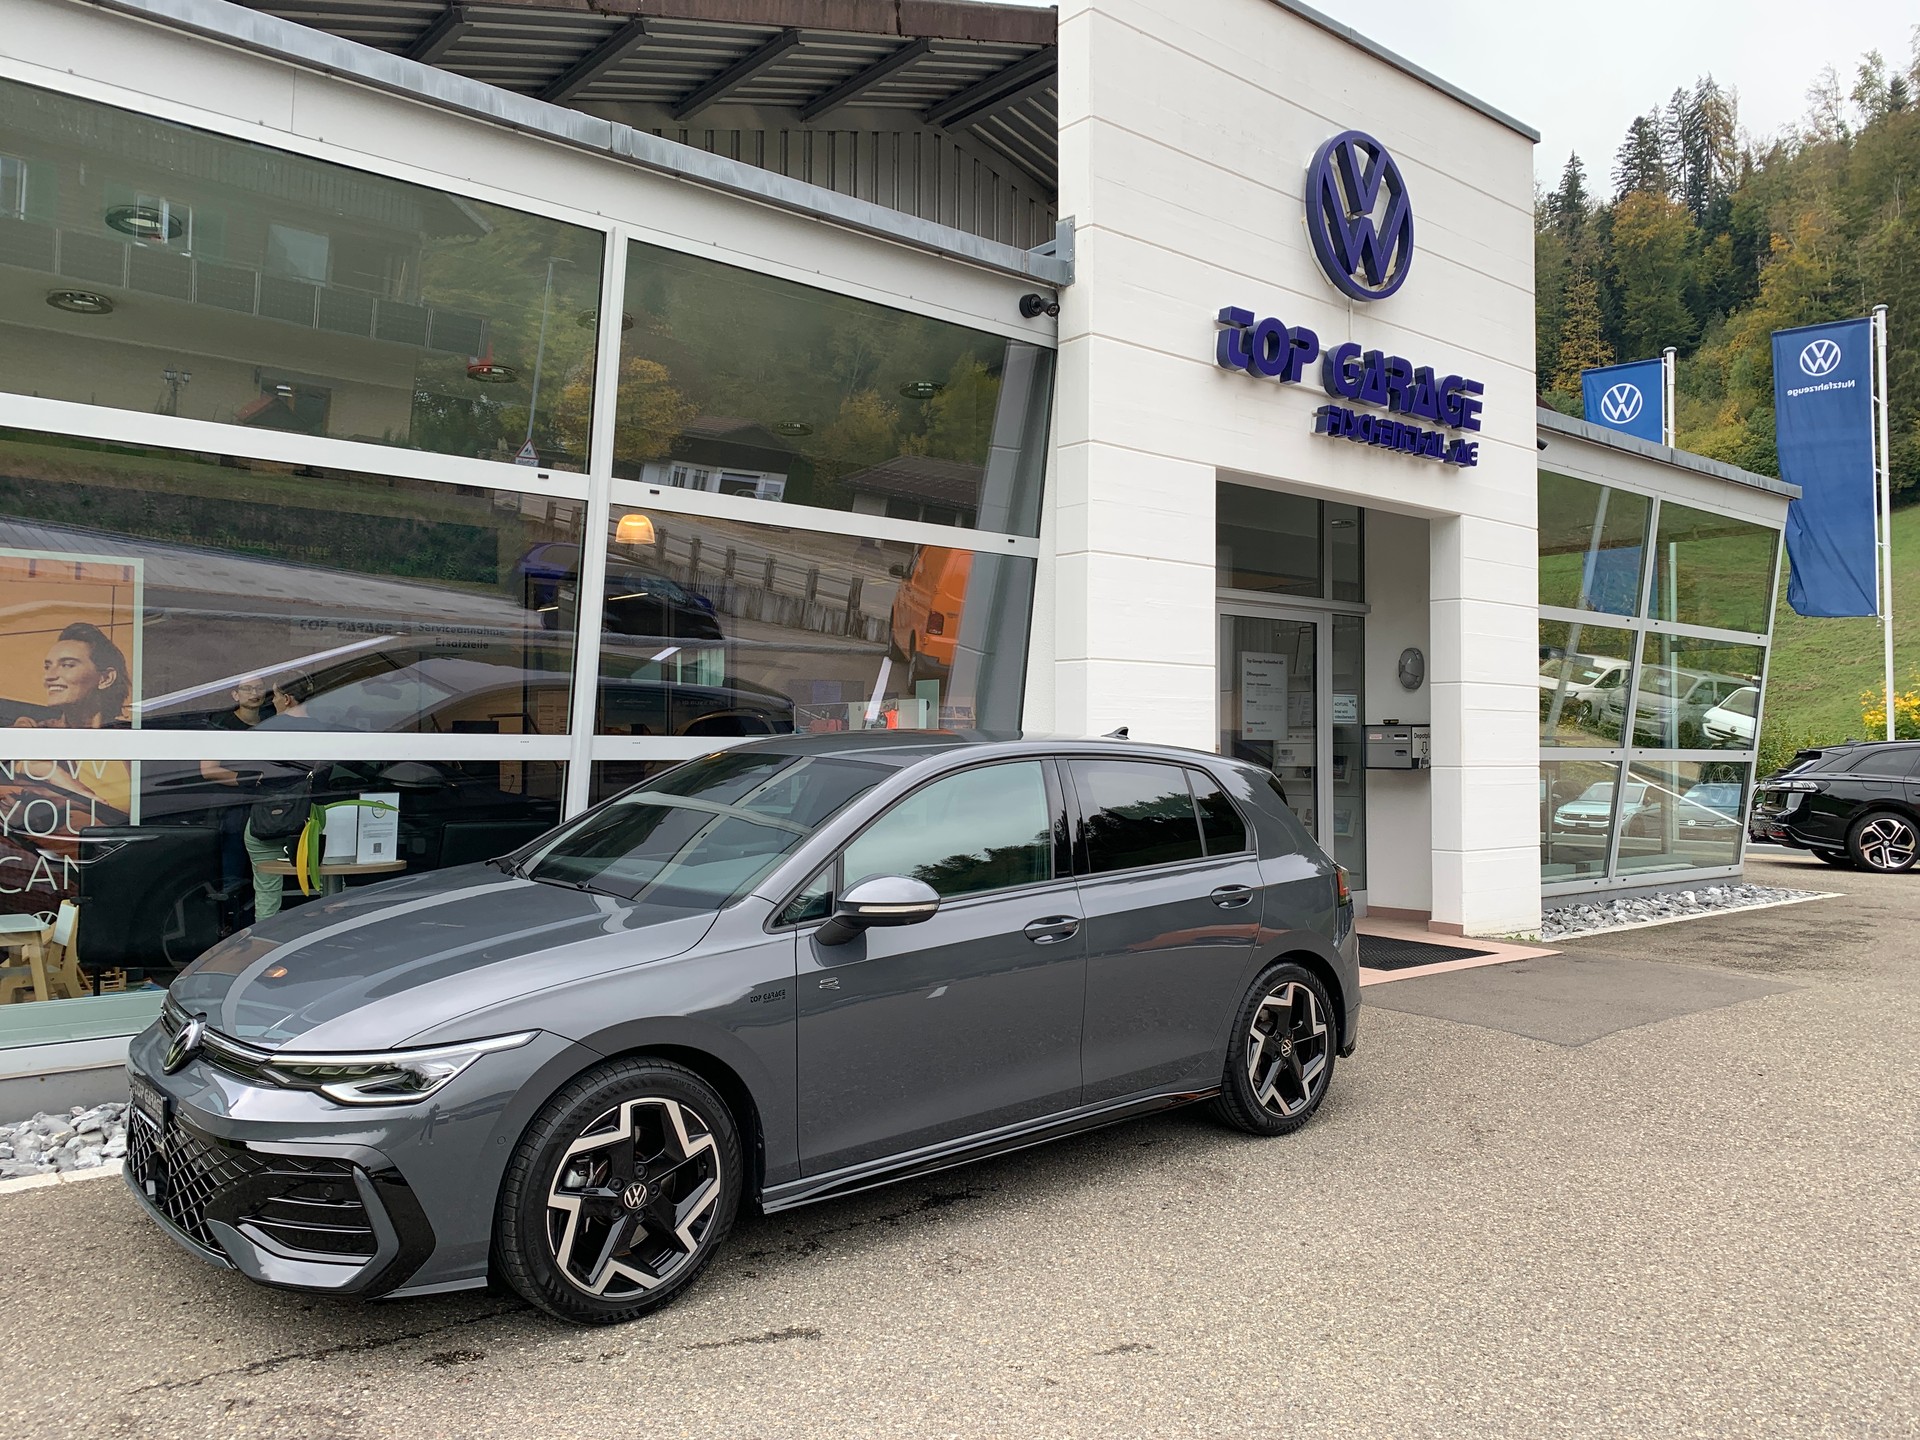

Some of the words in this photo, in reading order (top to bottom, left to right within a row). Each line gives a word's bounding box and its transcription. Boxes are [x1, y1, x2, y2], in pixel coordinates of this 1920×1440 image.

[1306, 130, 1414, 301] VW
[1216, 306, 1319, 383] TOP
[1322, 342, 1484, 432] GARAGE
[1601, 383, 1643, 424] VW
[0, 799, 96, 836] YOU
[750, 994, 762, 1003] TOP
[763, 989, 786, 1000] GARAGE
